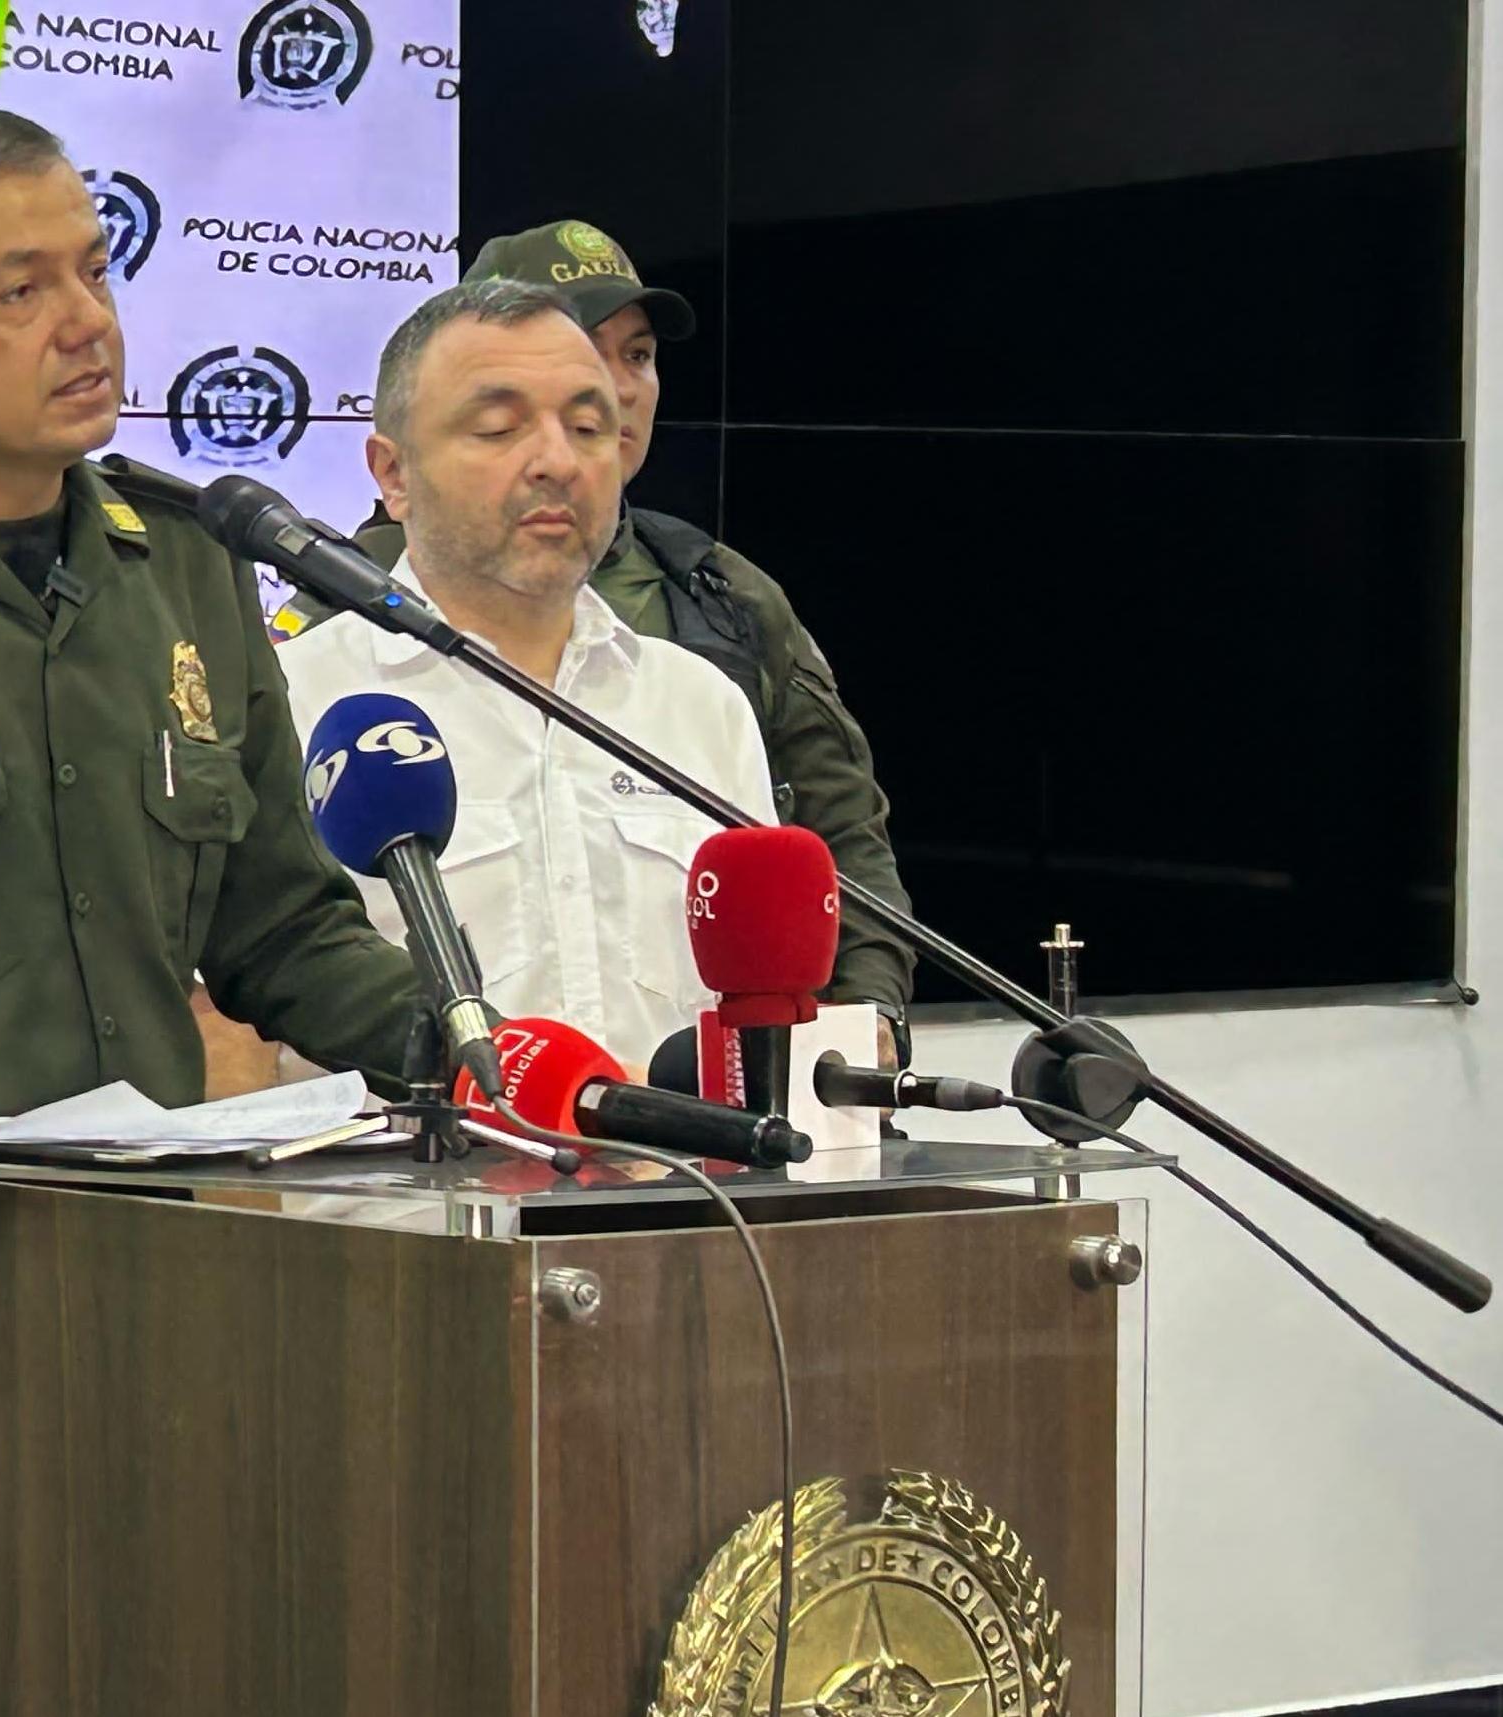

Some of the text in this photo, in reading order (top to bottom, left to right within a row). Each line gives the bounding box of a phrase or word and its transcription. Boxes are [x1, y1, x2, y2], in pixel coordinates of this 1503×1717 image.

[36, 13, 221, 52] NACIONAL
[183, 218, 303, 245] POLICIA
[217, 250, 433, 283] DE COLOMBIA
[857, 1546, 897, 1573] DE
